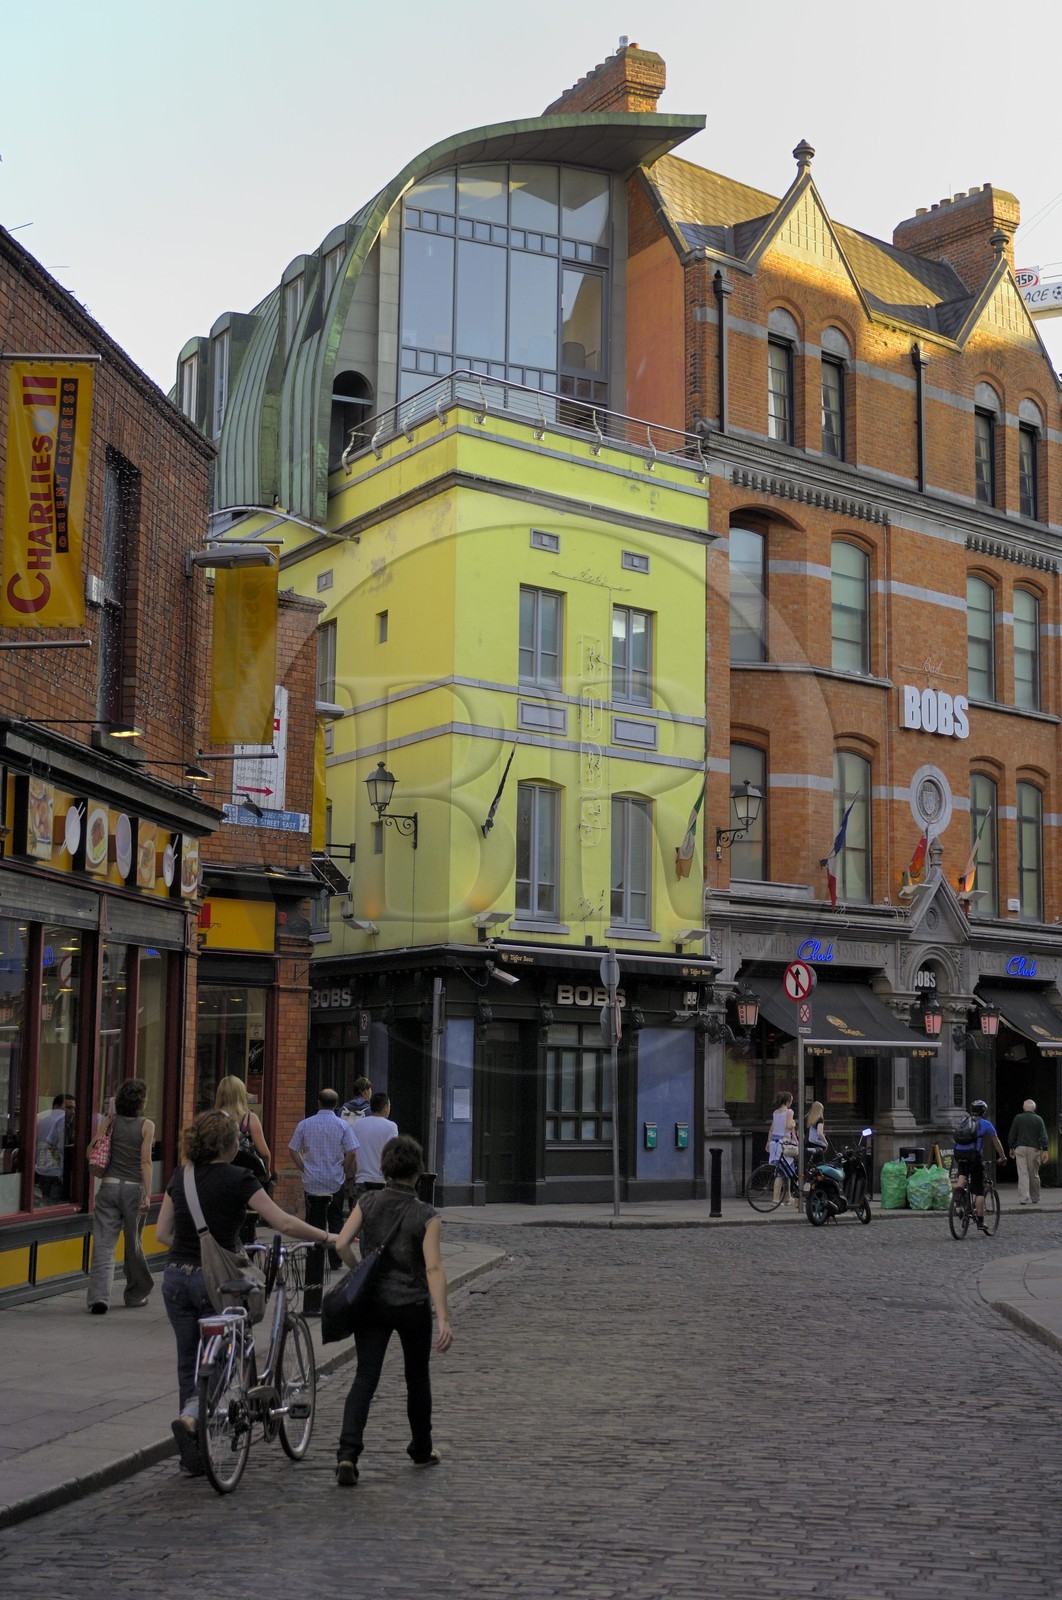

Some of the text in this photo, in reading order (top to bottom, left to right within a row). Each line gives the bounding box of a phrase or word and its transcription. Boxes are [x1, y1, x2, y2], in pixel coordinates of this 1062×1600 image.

[56, 382, 76, 548] ORIENT EXPRESS
[7, 435, 53, 613] CHARLIES
[922, 656, 944, 674] Bad
[902, 684, 970, 739] BOBS
[260, 818, 280, 827] STREET
[282, 821, 296, 829] EAST
[509, 953, 534, 964] Tiger Beer
[797, 938, 833, 962] Club
[1006, 955, 1037, 977] Club
[557, 984, 627, 1007] BOBS
